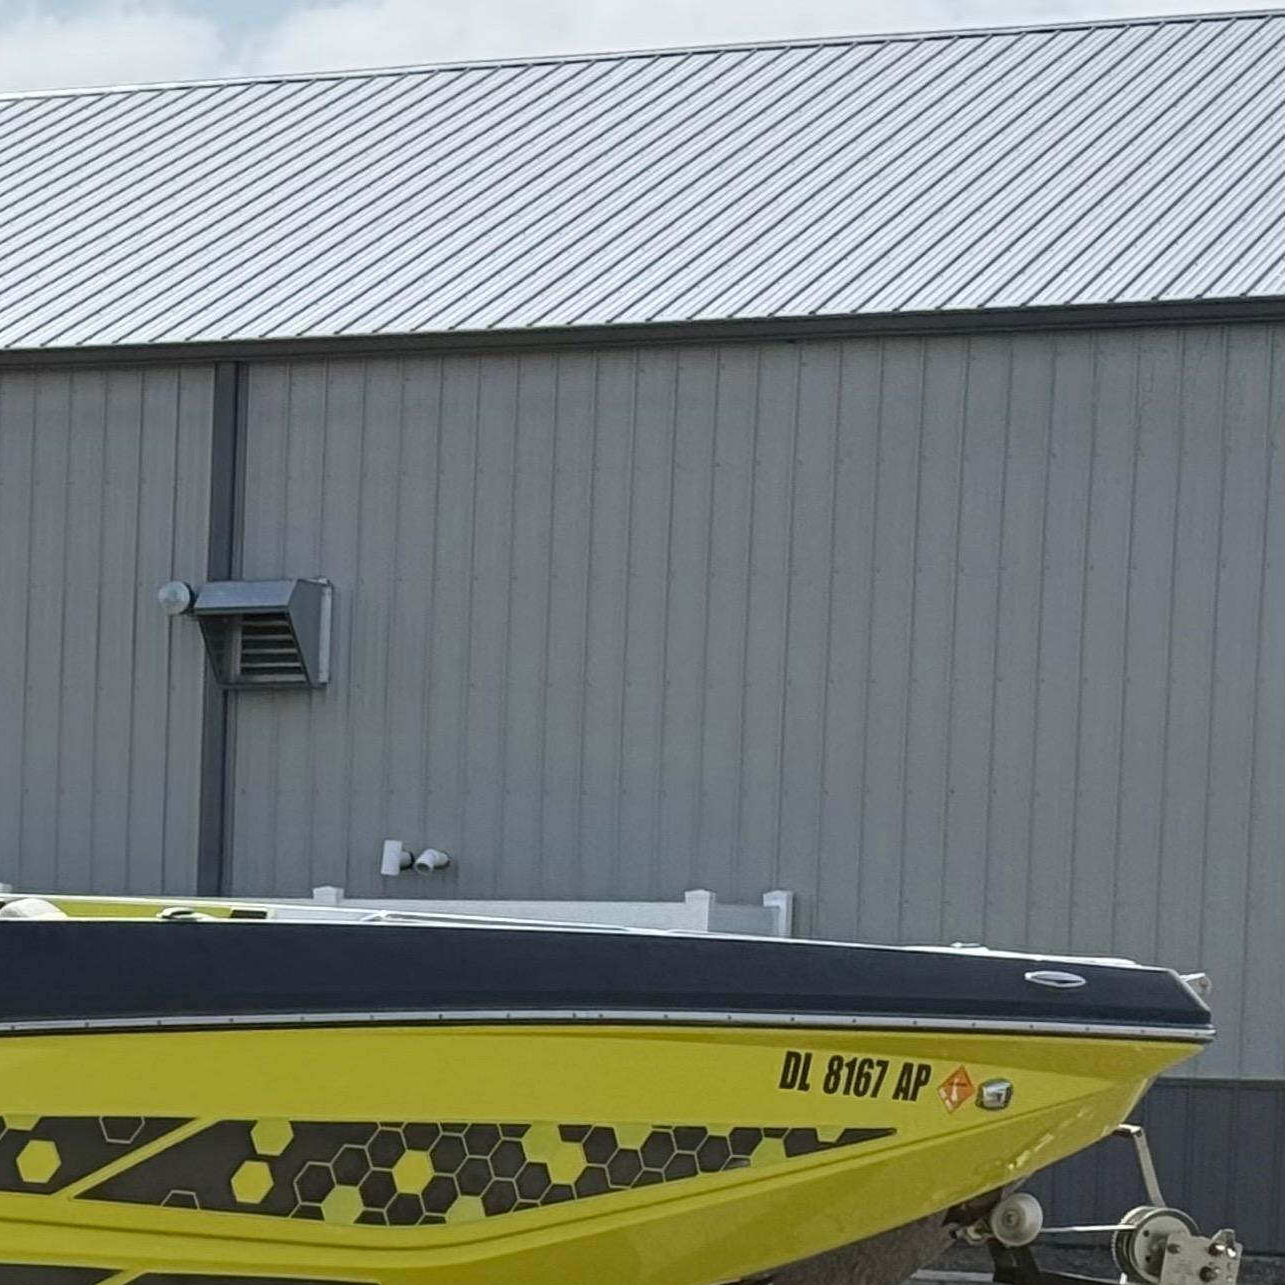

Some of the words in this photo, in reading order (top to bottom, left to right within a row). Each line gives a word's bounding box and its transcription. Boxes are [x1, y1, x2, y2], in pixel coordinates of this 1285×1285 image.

[778, 1050, 813, 1092] DL
[822, 1054, 890, 1098] 8167
[891, 1061, 932, 1102] AP
